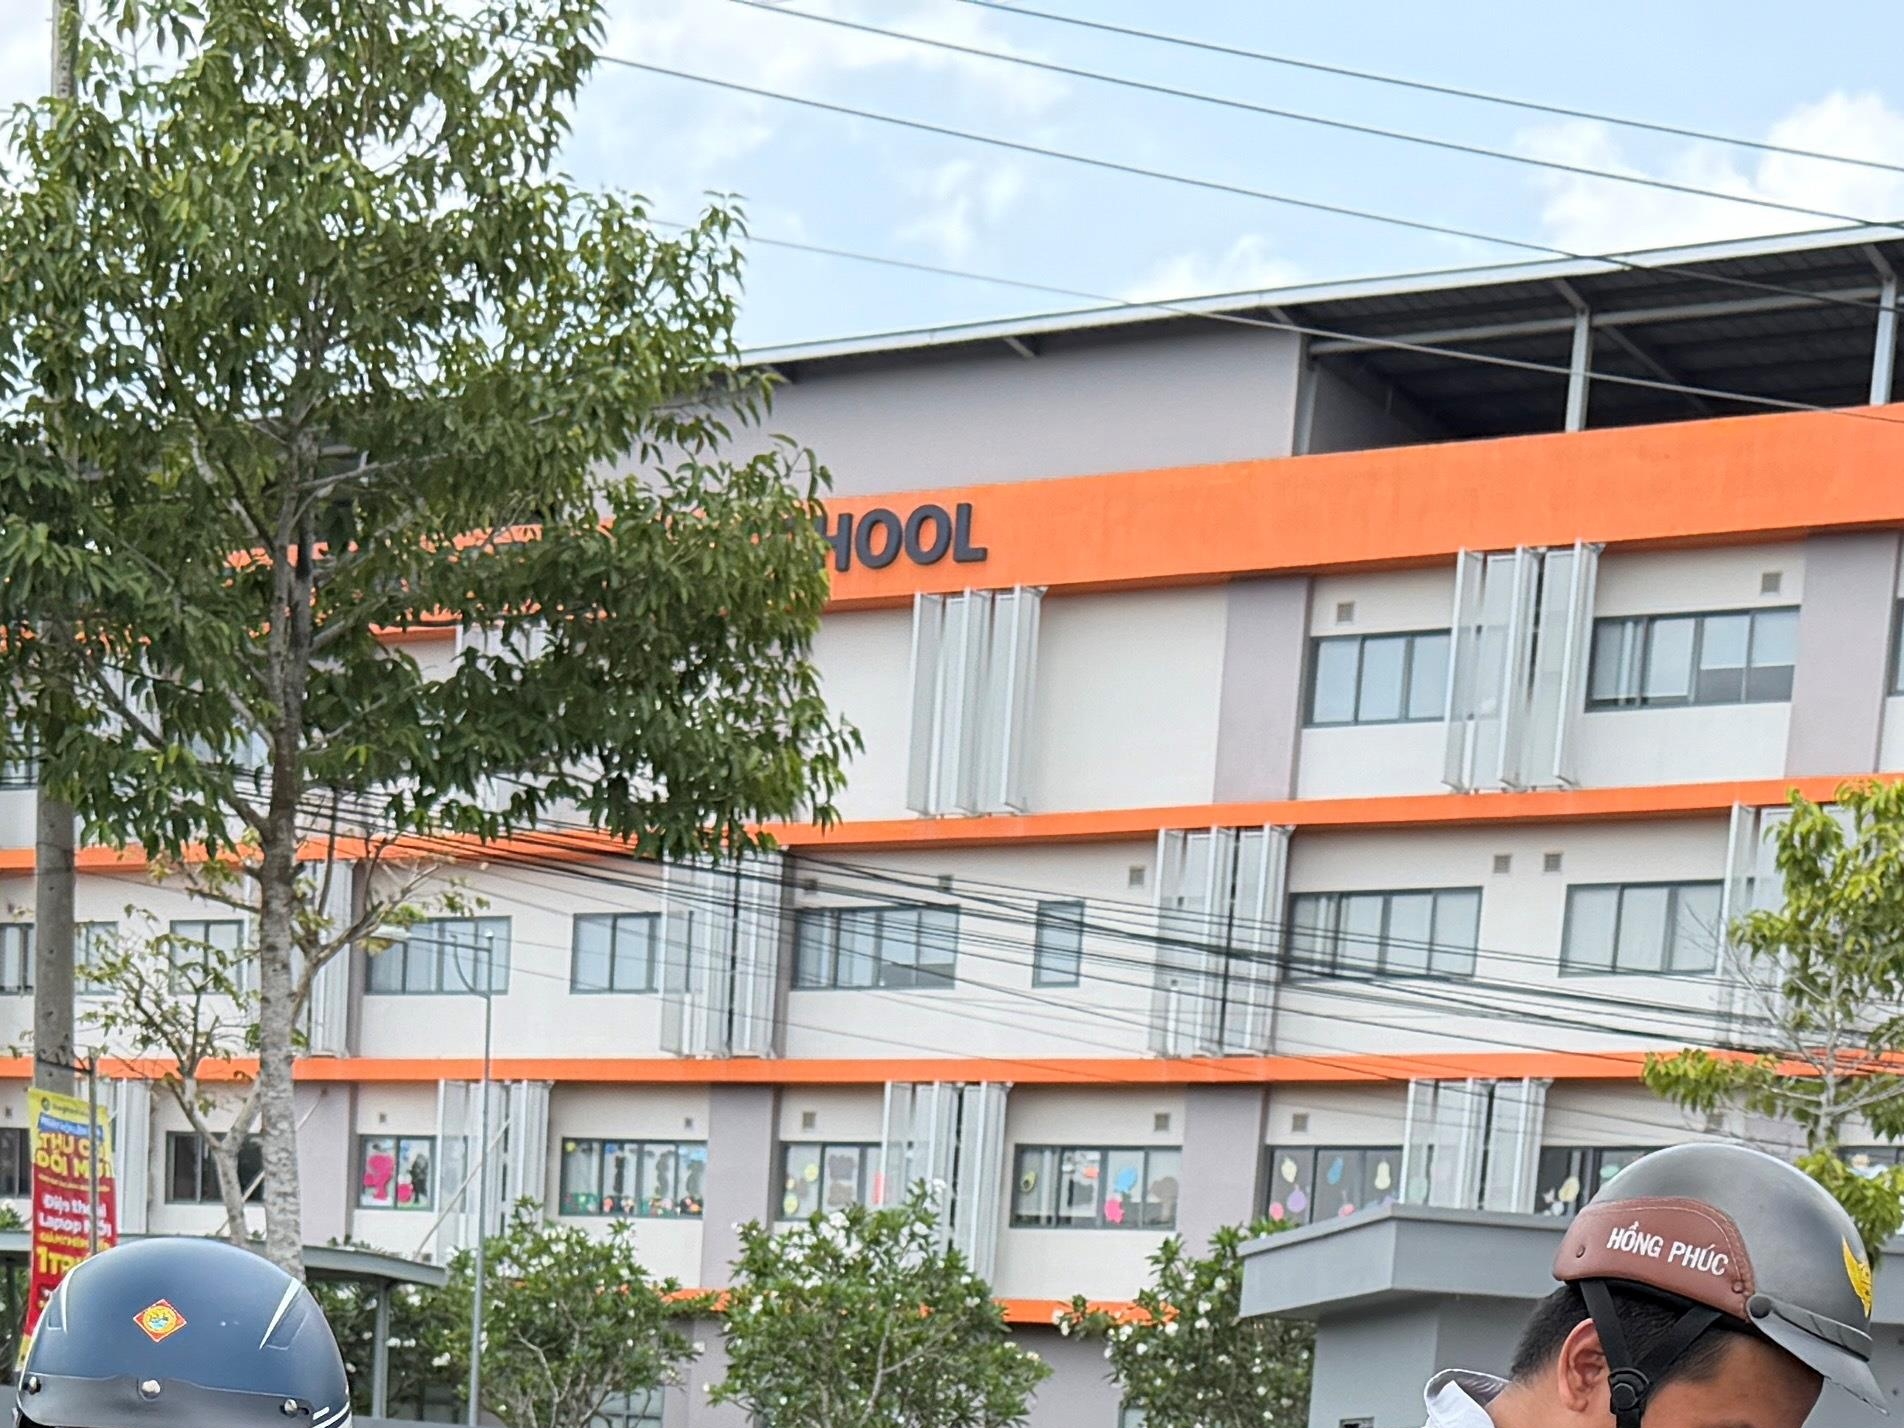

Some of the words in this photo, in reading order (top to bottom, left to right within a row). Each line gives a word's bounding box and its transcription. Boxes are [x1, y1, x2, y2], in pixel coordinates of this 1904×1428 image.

[820, 502, 988, 572] HOOL
[1606, 1220, 1665, 1258] HỒNG
[1667, 1243, 1729, 1276] PHÚC
